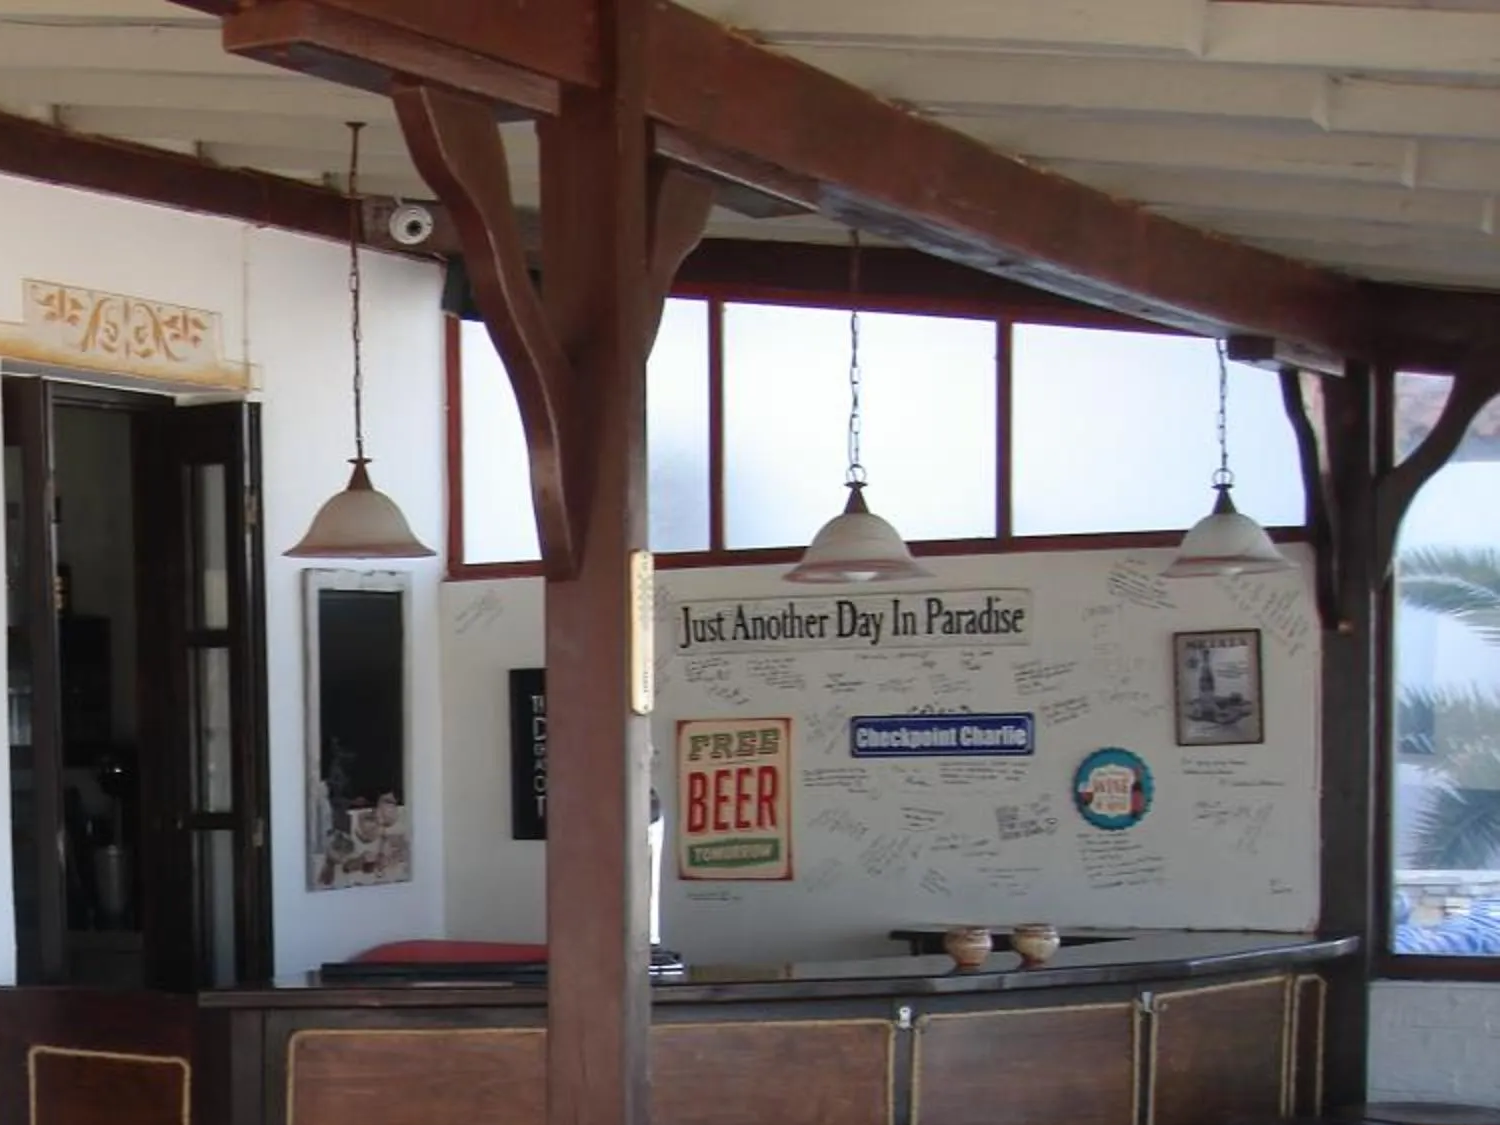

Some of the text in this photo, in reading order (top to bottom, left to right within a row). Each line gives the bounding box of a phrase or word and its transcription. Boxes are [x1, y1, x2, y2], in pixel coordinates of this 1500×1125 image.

[680, 596, 1024, 648] Just Another Day In Paradise
[689, 728, 781, 761] FREE
[856, 726, 1027, 748] Checkpoint Charlie
[687, 765, 778, 833] BEER
